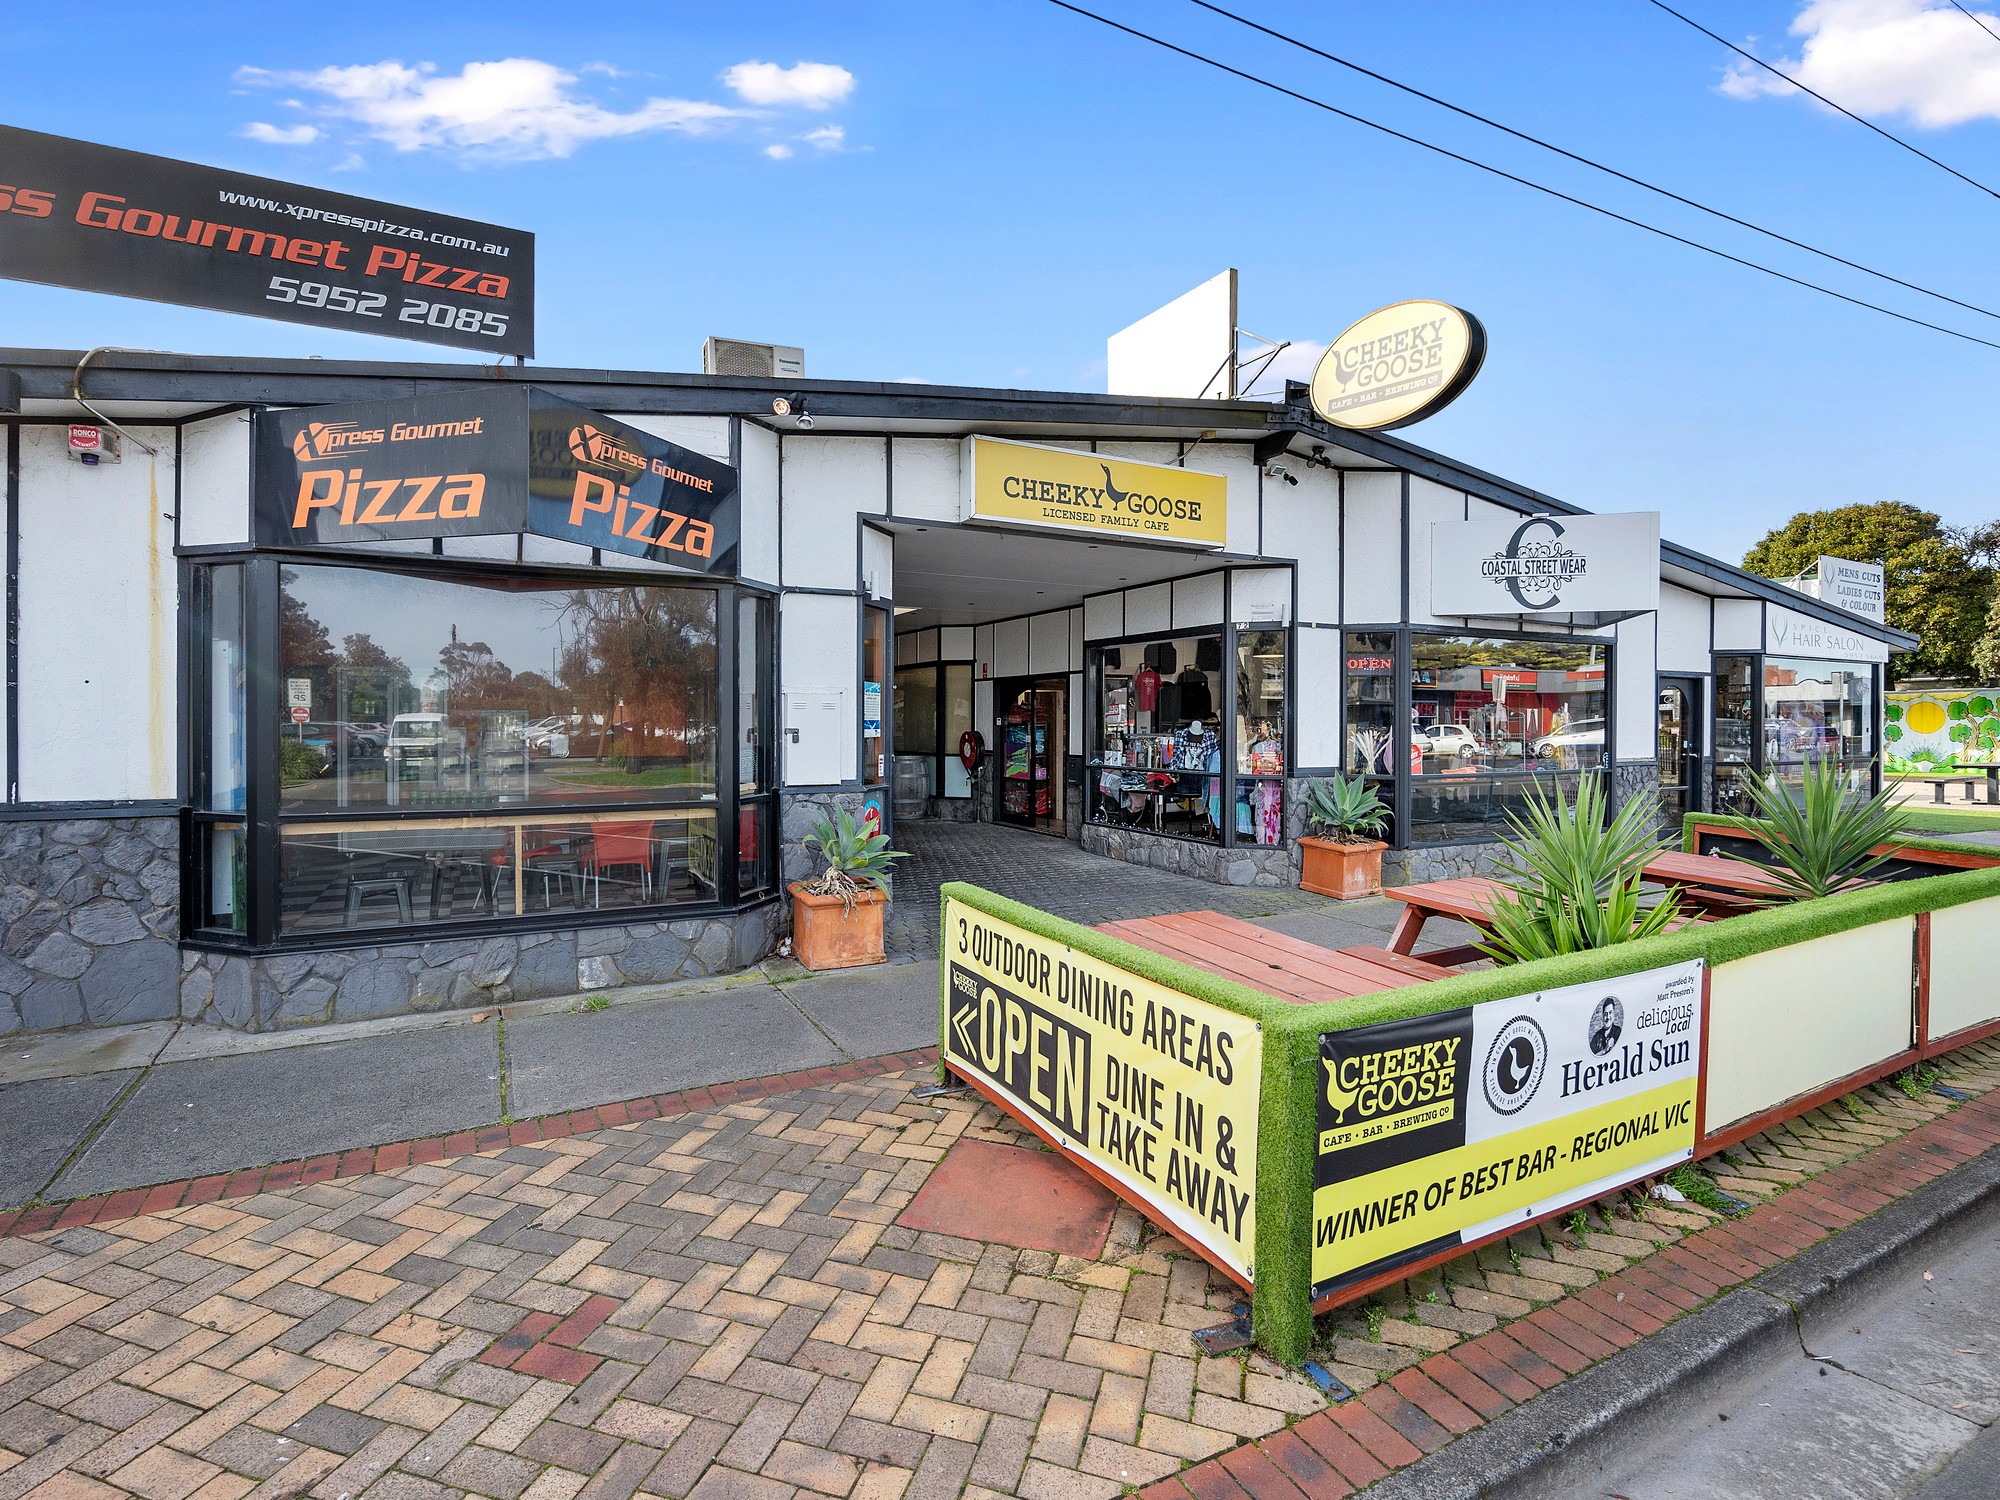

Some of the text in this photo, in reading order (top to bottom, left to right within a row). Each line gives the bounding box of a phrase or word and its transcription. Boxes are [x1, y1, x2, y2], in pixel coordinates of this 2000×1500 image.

[75, 191, 352, 271] Gourmet
[364, 244, 511, 299] Pizza
[218, 189, 510, 258] www.xpresspizza.com.au
[266, 276, 510, 338] 5952 2085
[1344, 317, 1446, 369] CHEEKY
[1357, 342, 1443, 387] GOOSE
[1331, 398, 1354, 410] CAFE
[1359, 391, 1377, 403] BAR
[1384, 379, 1427, 396] BREWING
[73, 428, 97, 438] RONCO
[293, 416, 484, 461] Xpress Gourmet
[568, 424, 648, 470] Xpress
[651, 458, 714, 494] Gourmet
[292, 469, 486, 529] Pizza
[568, 470, 715, 559] Pizza
[1003, 476, 1202, 522] CHEEKY GOOSE
[1042, 508, 1170, 532] LICENSED FAMILY CAFE
[1481, 558, 1586, 576] COASTAL STREET WEAR
[1838, 566, 1881, 583] MENS CUTS
[1837, 585, 1881, 601] LADIES CUTS
[1849, 601, 1877, 613] COLOUR
[1347, 659, 1392, 669] OPEN
[1792, 632, 1864, 651] HAIR SALON
[955, 971, 978, 990] CHEEKY
[958, 981, 978, 999] GOOSE
[958, 918, 1235, 1086] 3 OUTDOOR DINING AREAS
[1656, 986, 1694, 1003] Matt Preston's
[1665, 975, 1695, 989] awarded by
[1496, 1033, 1511, 1055] CHEEKY
[1512, 1025, 1527, 1035] GOOSE
[1665, 1015, 1692, 1036] Local
[980, 986, 1086, 1135] OPEN
[1340, 1036, 1462, 1090] CHEEKY
[1560, 1039, 1690, 1099] Herald Sun
[1358, 1066, 1456, 1117] GOOSE
[1105, 1054, 1238, 1178] DINE IN &
[1323, 1132, 1352, 1148] CAFE
[1362, 1125, 1384, 1139] BAR
[1393, 1110, 1438, 1130] BREWING
[1096, 1101, 1250, 1243] TAKE AWAY
[1316, 1188, 1417, 1249] WINNER
[1424, 1175, 1457, 1213] OF
[1459, 1157, 1514, 1201] BEST
[1515, 1145, 1556, 1182] BAR
[1571, 1115, 1661, 1164] REGIONAL
[1663, 1100, 1692, 1132] VIC
